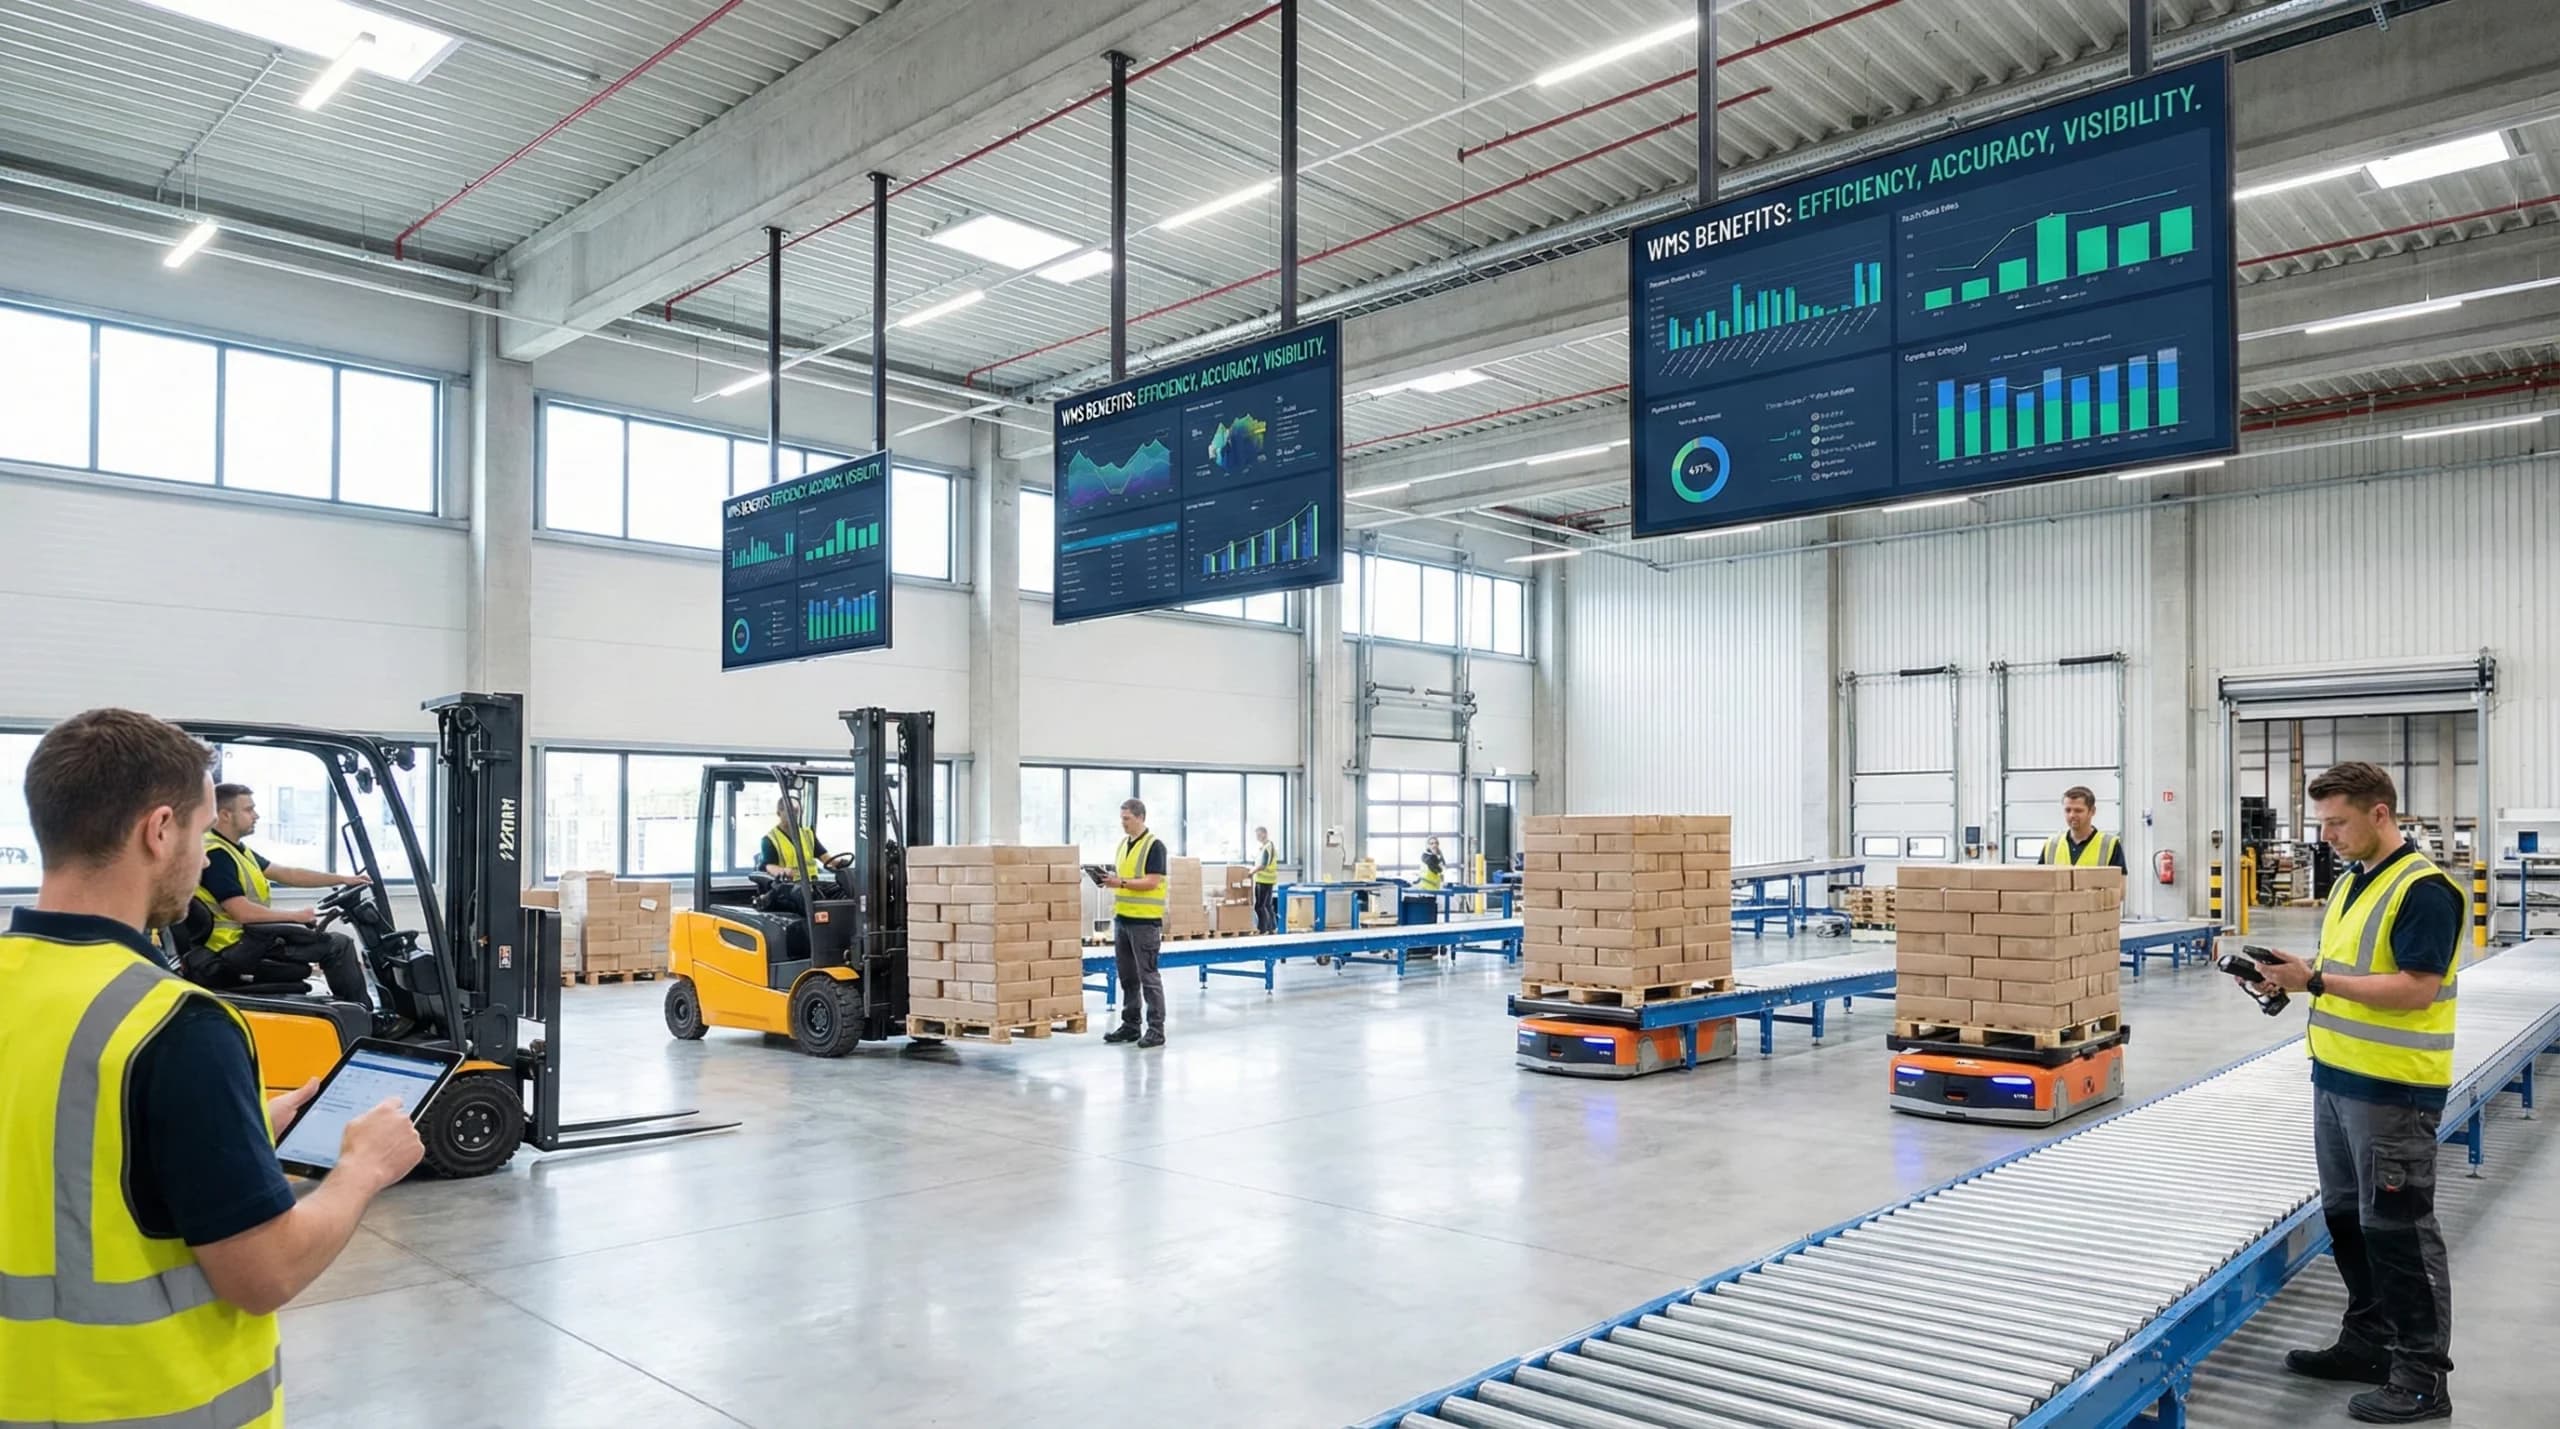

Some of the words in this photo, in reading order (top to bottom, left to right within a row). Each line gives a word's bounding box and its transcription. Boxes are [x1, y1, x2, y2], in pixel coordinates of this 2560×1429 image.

[1647, 231, 1690, 261] WMS
[1695, 202, 1793, 248] BENEFITS:
[1798, 164, 1922, 220] EFFICIENCY,
[1928, 126, 2055, 183] ACCURACY,
[2063, 84, 2202, 145] VISIBILITY.
[1061, 404, 1085, 427] WMS
[1137, 373, 1199, 405] EFFICIENCY,
[1201, 357, 1261, 388] ACCURACY,
[1263, 336, 1326, 369] VISIBILITY.
